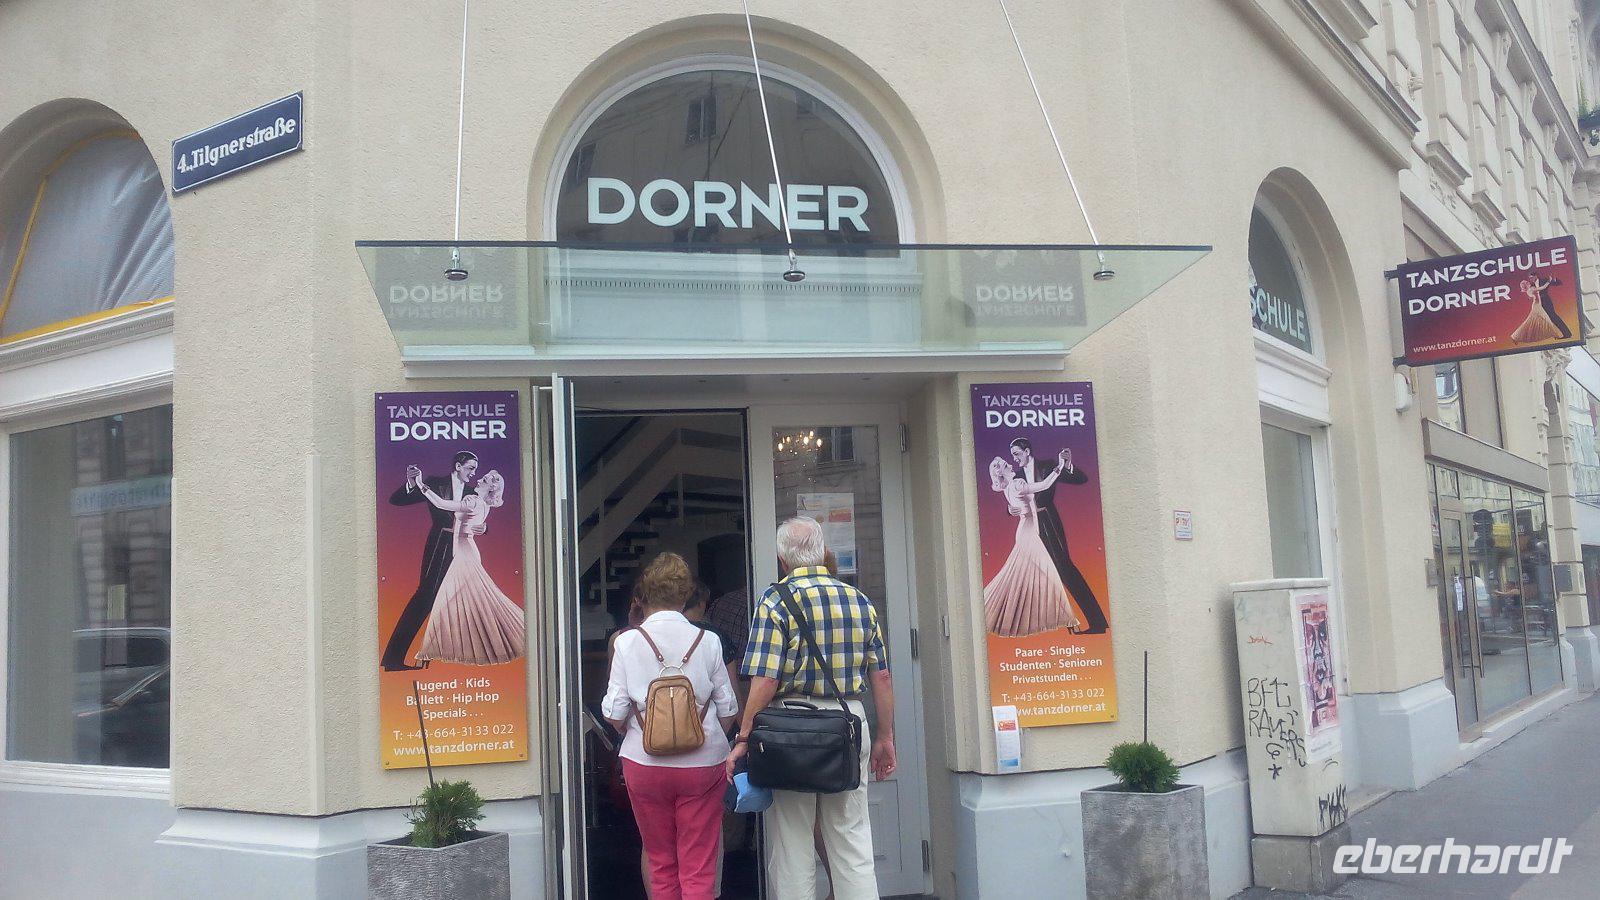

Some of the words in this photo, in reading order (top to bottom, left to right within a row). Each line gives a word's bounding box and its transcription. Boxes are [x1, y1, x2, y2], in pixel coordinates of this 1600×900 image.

[588, 177, 870, 232] DORNER
[1406, 247, 1568, 289] TANZSCHULE
[1408, 284, 1511, 315] DORNER
[1413, 335, 1497, 354] www.tanzdorner.at
[982, 394, 1084, 407] TANZSCHULE
[387, 403, 506, 418] TANZSCHULE
[985, 409, 1085, 428] DORNER
[390, 420, 507, 441] DORNER
[1015, 647, 1043, 658] Paare
[1050, 645, 1085, 657] Singles
[1000, 661, 1051, 671] Studenten
[1058, 658, 1102, 668] Senioren
[466, 677, 490, 688] Kids
[1012, 672, 1077, 684] Privatstunden
[452, 693, 473, 705] Hip
[475, 692, 499, 703] Hop
[1002, 693, 1011, 703] T:
[1086, 688, 1105, 697] 022
[423, 708, 467, 721] Specials
[393, 730, 403, 741] T:
[492, 724, 514, 735] 022
[393, 739, 515, 756] wwwtanzdorner.at
